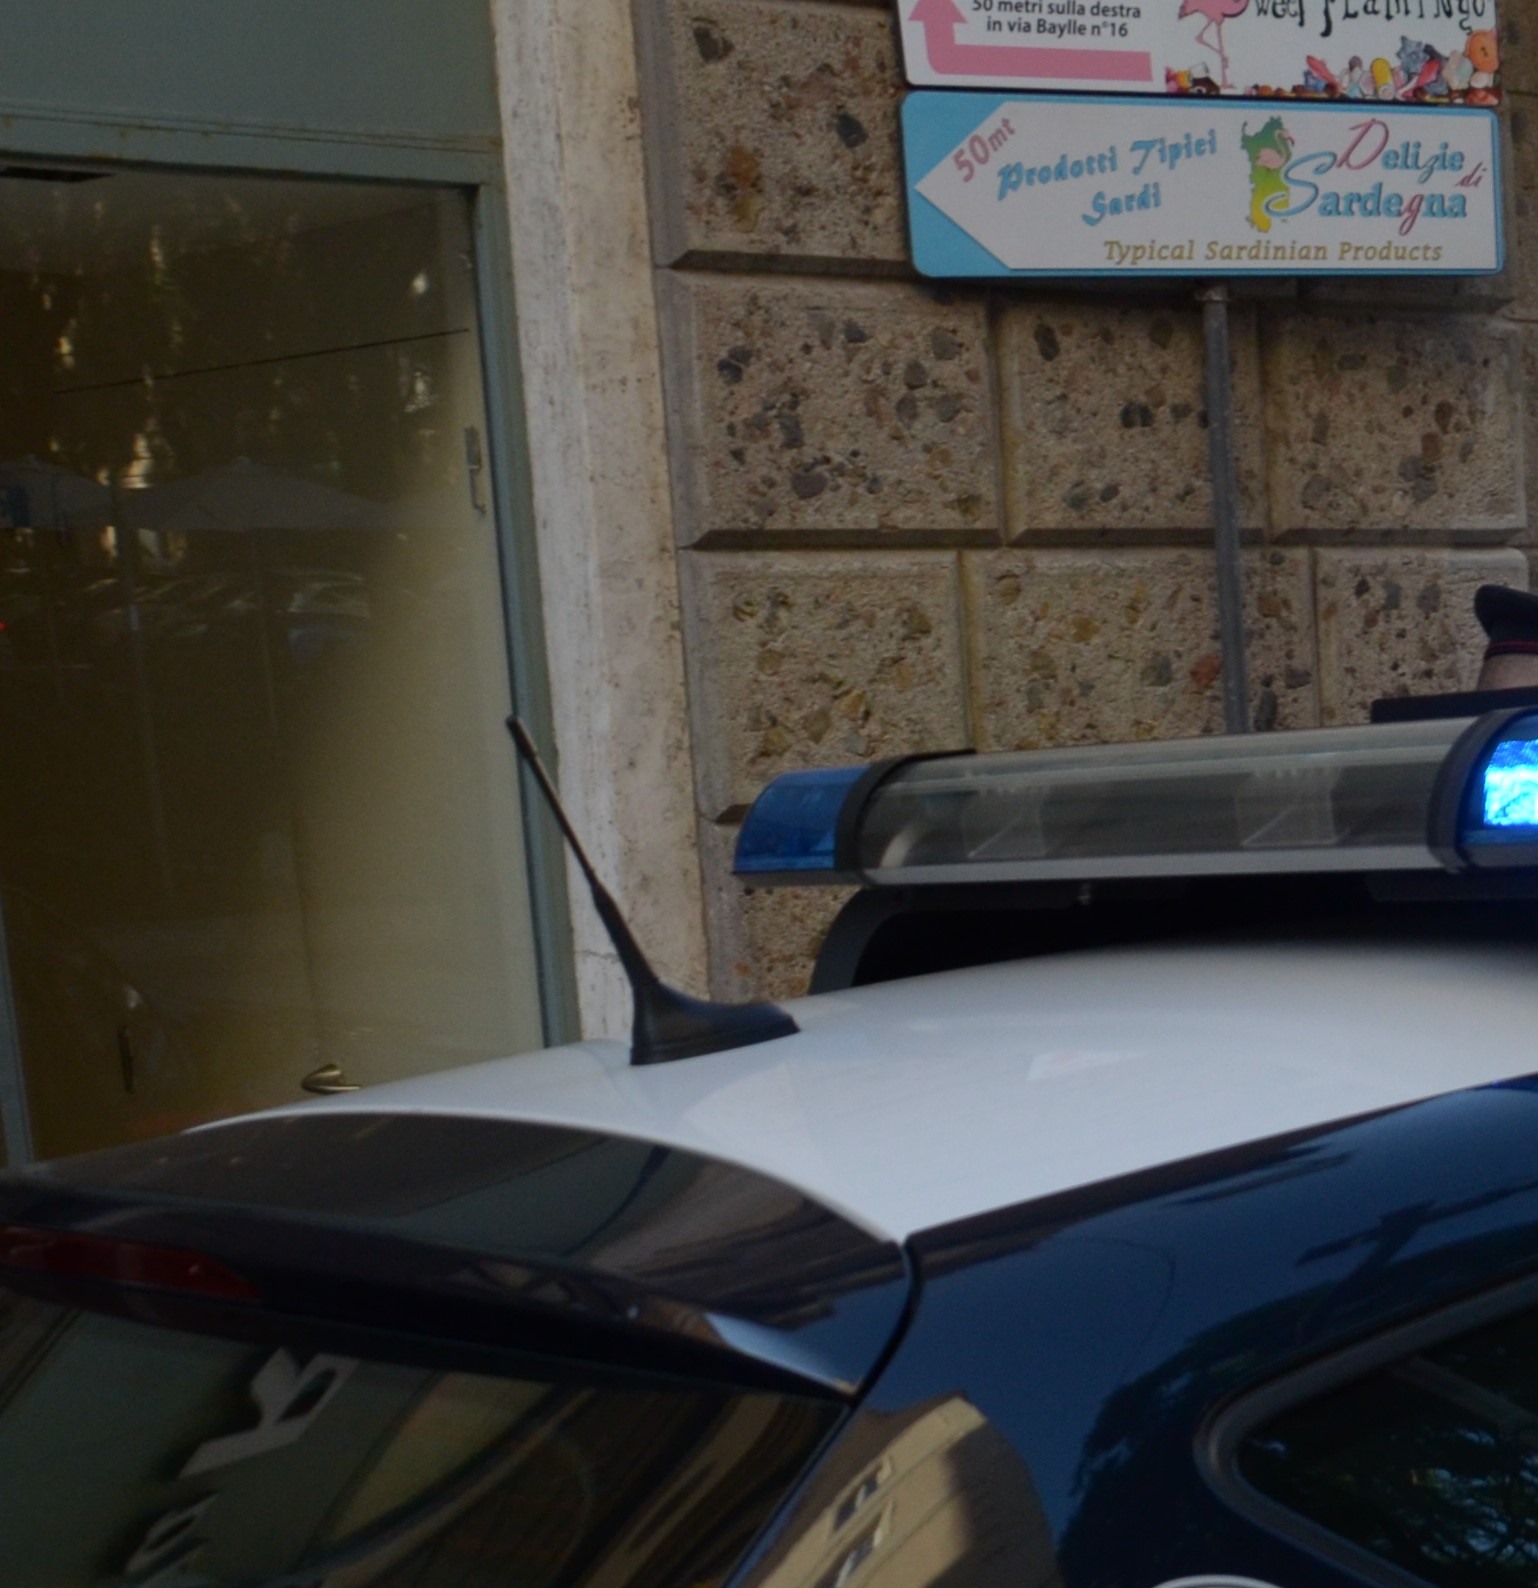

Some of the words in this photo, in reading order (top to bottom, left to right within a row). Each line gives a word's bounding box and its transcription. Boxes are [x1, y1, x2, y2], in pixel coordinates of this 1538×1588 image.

[972, 0, 993, 11] 50
[998, 0, 1043, 14] metri
[1048, 0, 1085, 16] sulla
[1090, 1, 1141, 18] destra
[986, 16, 1002, 32] in
[1007, 17, 1032, 33] via
[1036, 18, 1087, 39] Baylle
[1091, 22, 1128, 37] n°16
[953, 118, 1015, 183] 50mt
[997, 146, 1118, 202] Prodotti
[1130, 128, 1217, 176] Tipici
[1335, 118, 1465, 184] Delizie
[1454, 161, 1487, 187] di
[1082, 182, 1162, 226] Sardi
[1264, 152, 1467, 236] Sardegna
[1103, 240, 1195, 265] Typical
[1204, 240, 1329, 261] Sardinian
[1338, 241, 1443, 262] Products
